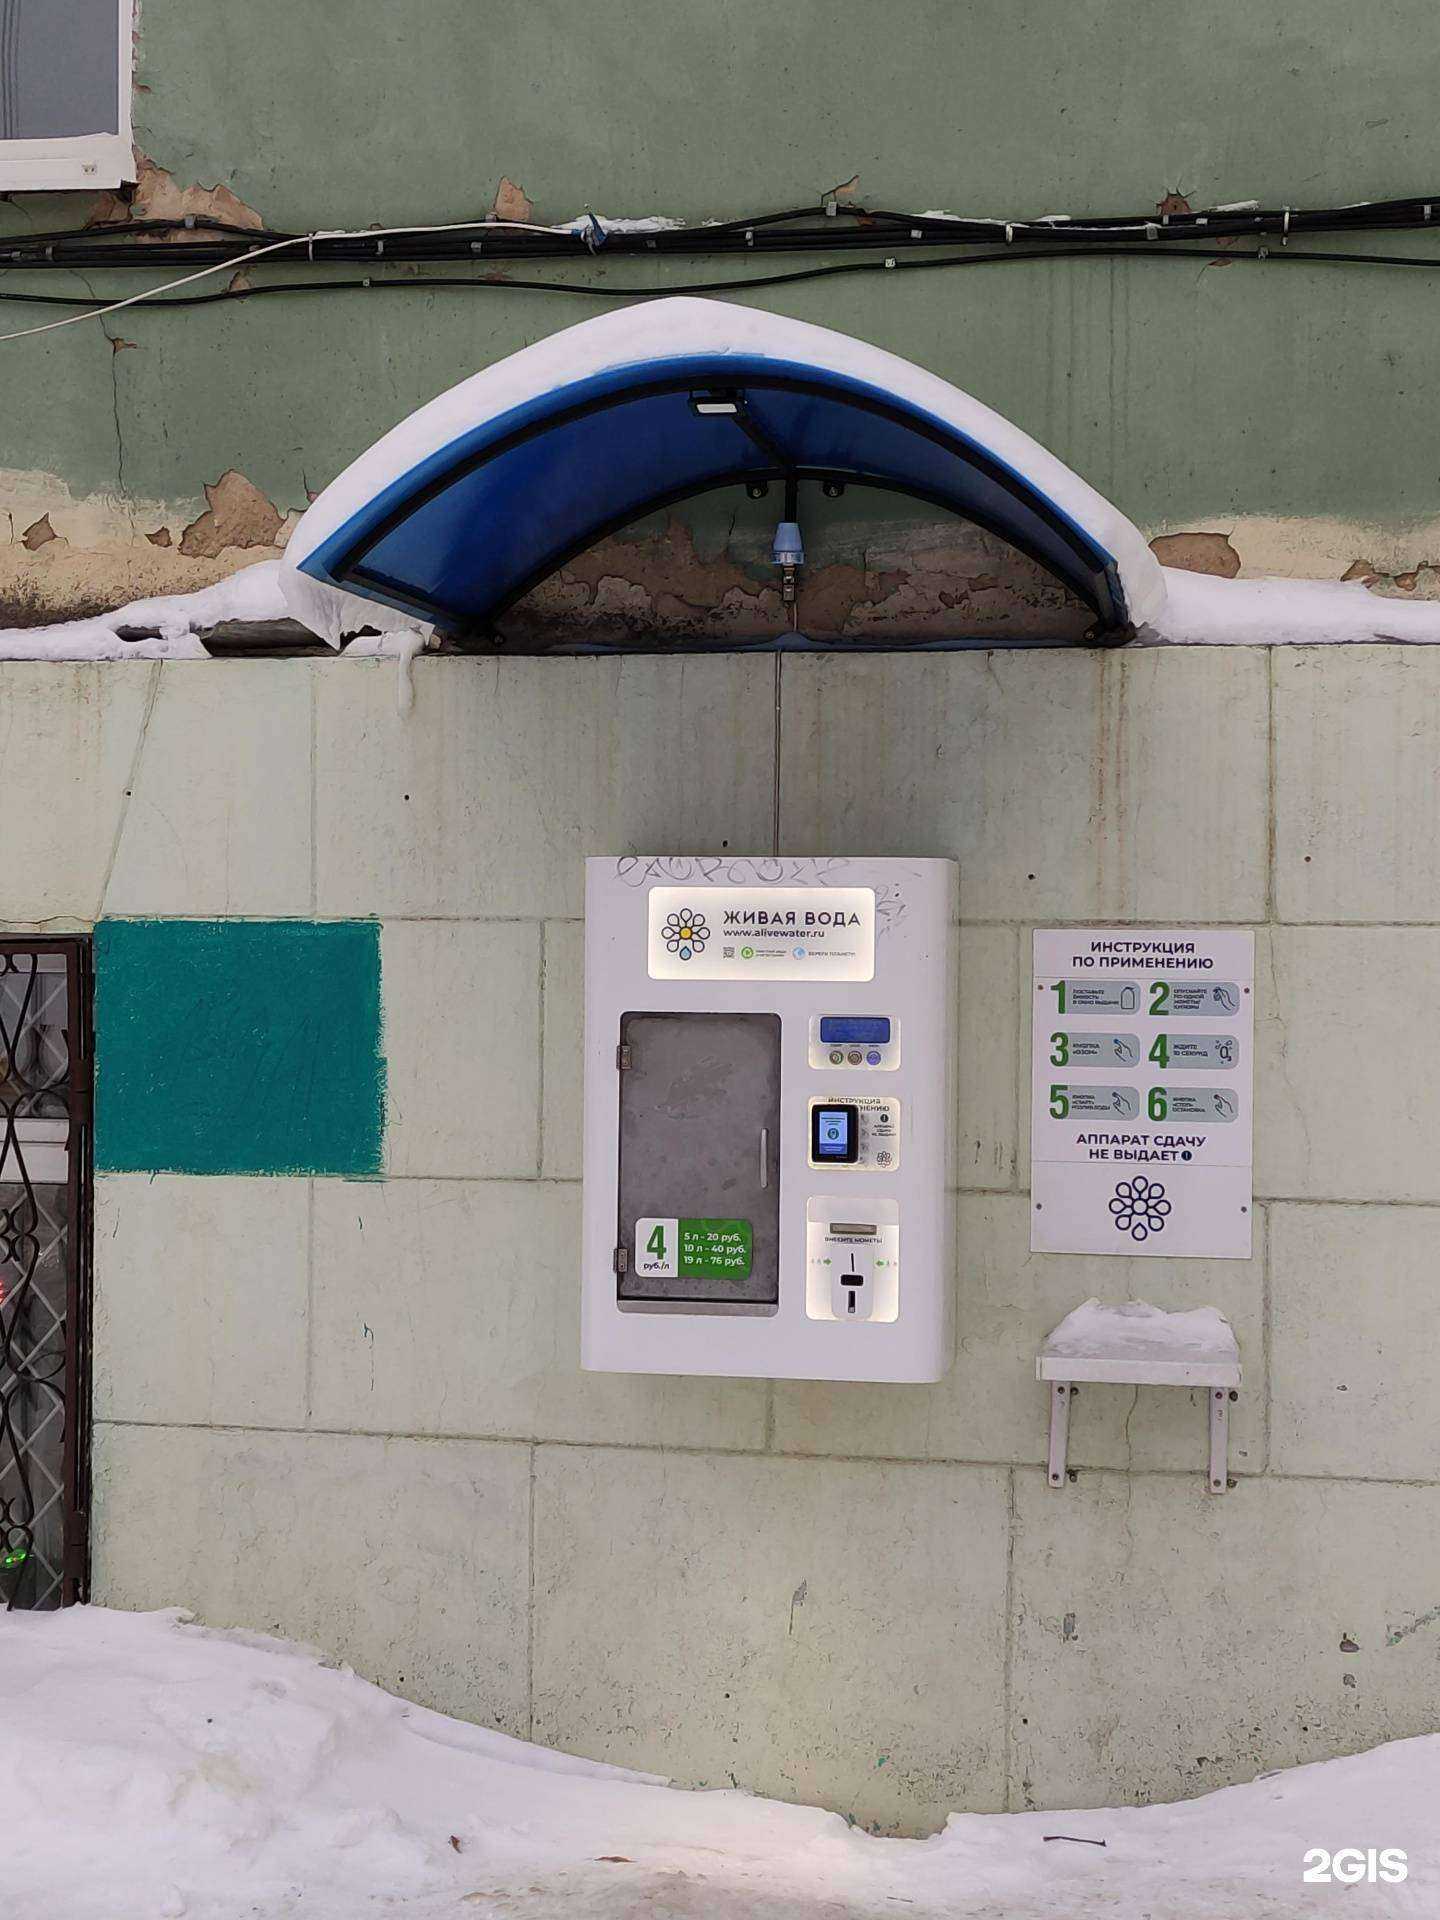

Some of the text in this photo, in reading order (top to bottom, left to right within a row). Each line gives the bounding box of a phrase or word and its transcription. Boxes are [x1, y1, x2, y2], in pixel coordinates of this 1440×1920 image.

[723, 911, 861, 927] ЖИВАЯ ВОДА
[723, 928, 825, 938] www.alivewater.ru
[1091, 941, 1195, 955] ИНСТРУКЦИЯ
[1072, 956, 1214, 969] ПО ПРИМЕНЕНИЮ
[1050, 980, 1066, 1014] 1
[1149, 981, 1170, 1016] 2
[1050, 1032, 1069, 1067] 3
[1148, 1034, 1170, 1069] 4
[1049, 1084, 1069, 1119] 5
[1148, 1086, 1168, 1122] 6
[1076, 1134, 1207, 1148] АППАРАТ СДАЧУ
[1089, 1149, 1109, 1159] НЕ
[646, 1225, 667, 1260] 4
[684, 1232, 691, 1241] 5
[692, 1233, 699, 1241] л
[706, 1233, 719, 1241] 20
[721, 1232, 742, 1243] руб.
[684, 1244, 695, 1252] 10
[726, 1245, 747, 1255] руб.
[643, 1262, 670, 1271] руб./л
[683, 1255, 694, 1264] 19
[695, 1256, 703, 1264] л
[710, 1256, 723, 1264] 76
[724, 1256, 745, 1267] руб.
